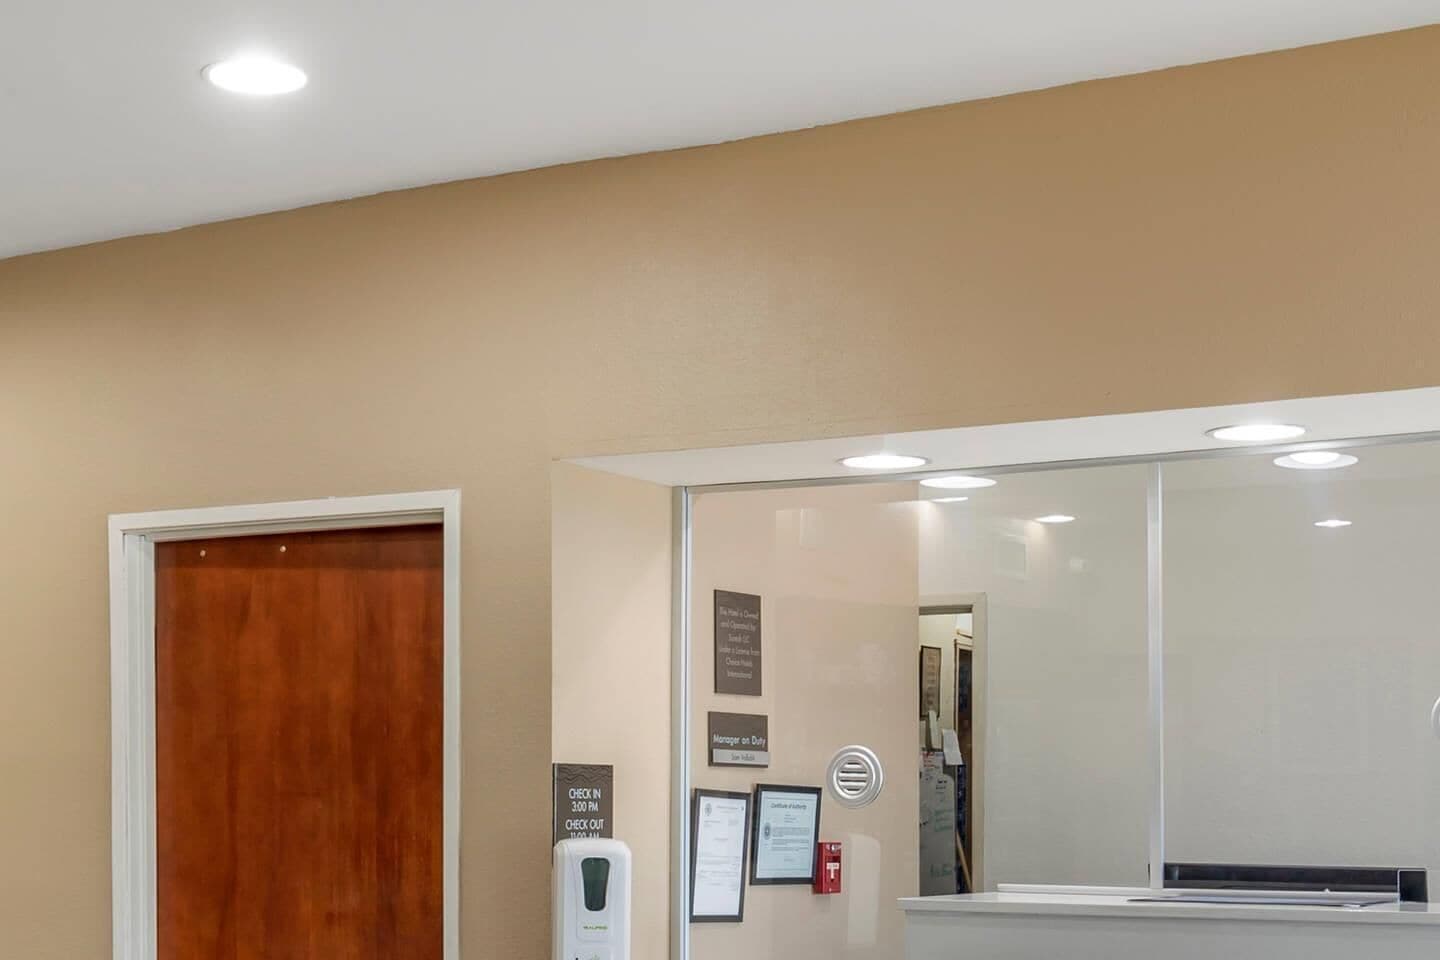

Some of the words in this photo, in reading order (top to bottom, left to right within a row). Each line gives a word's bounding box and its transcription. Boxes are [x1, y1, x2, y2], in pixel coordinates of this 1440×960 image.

[712, 733, 740, 747] Manager
[741, 737, 750, 745] on
[751, 735, 767, 749] Duty
[568, 788, 592, 799] CHECK
[592, 788, 602, 799] IN
[571, 801, 587, 812] 3:00
[588, 801, 599, 812] PM
[565, 819, 588, 830] CHECK
[589, 819, 605, 830] OUT
